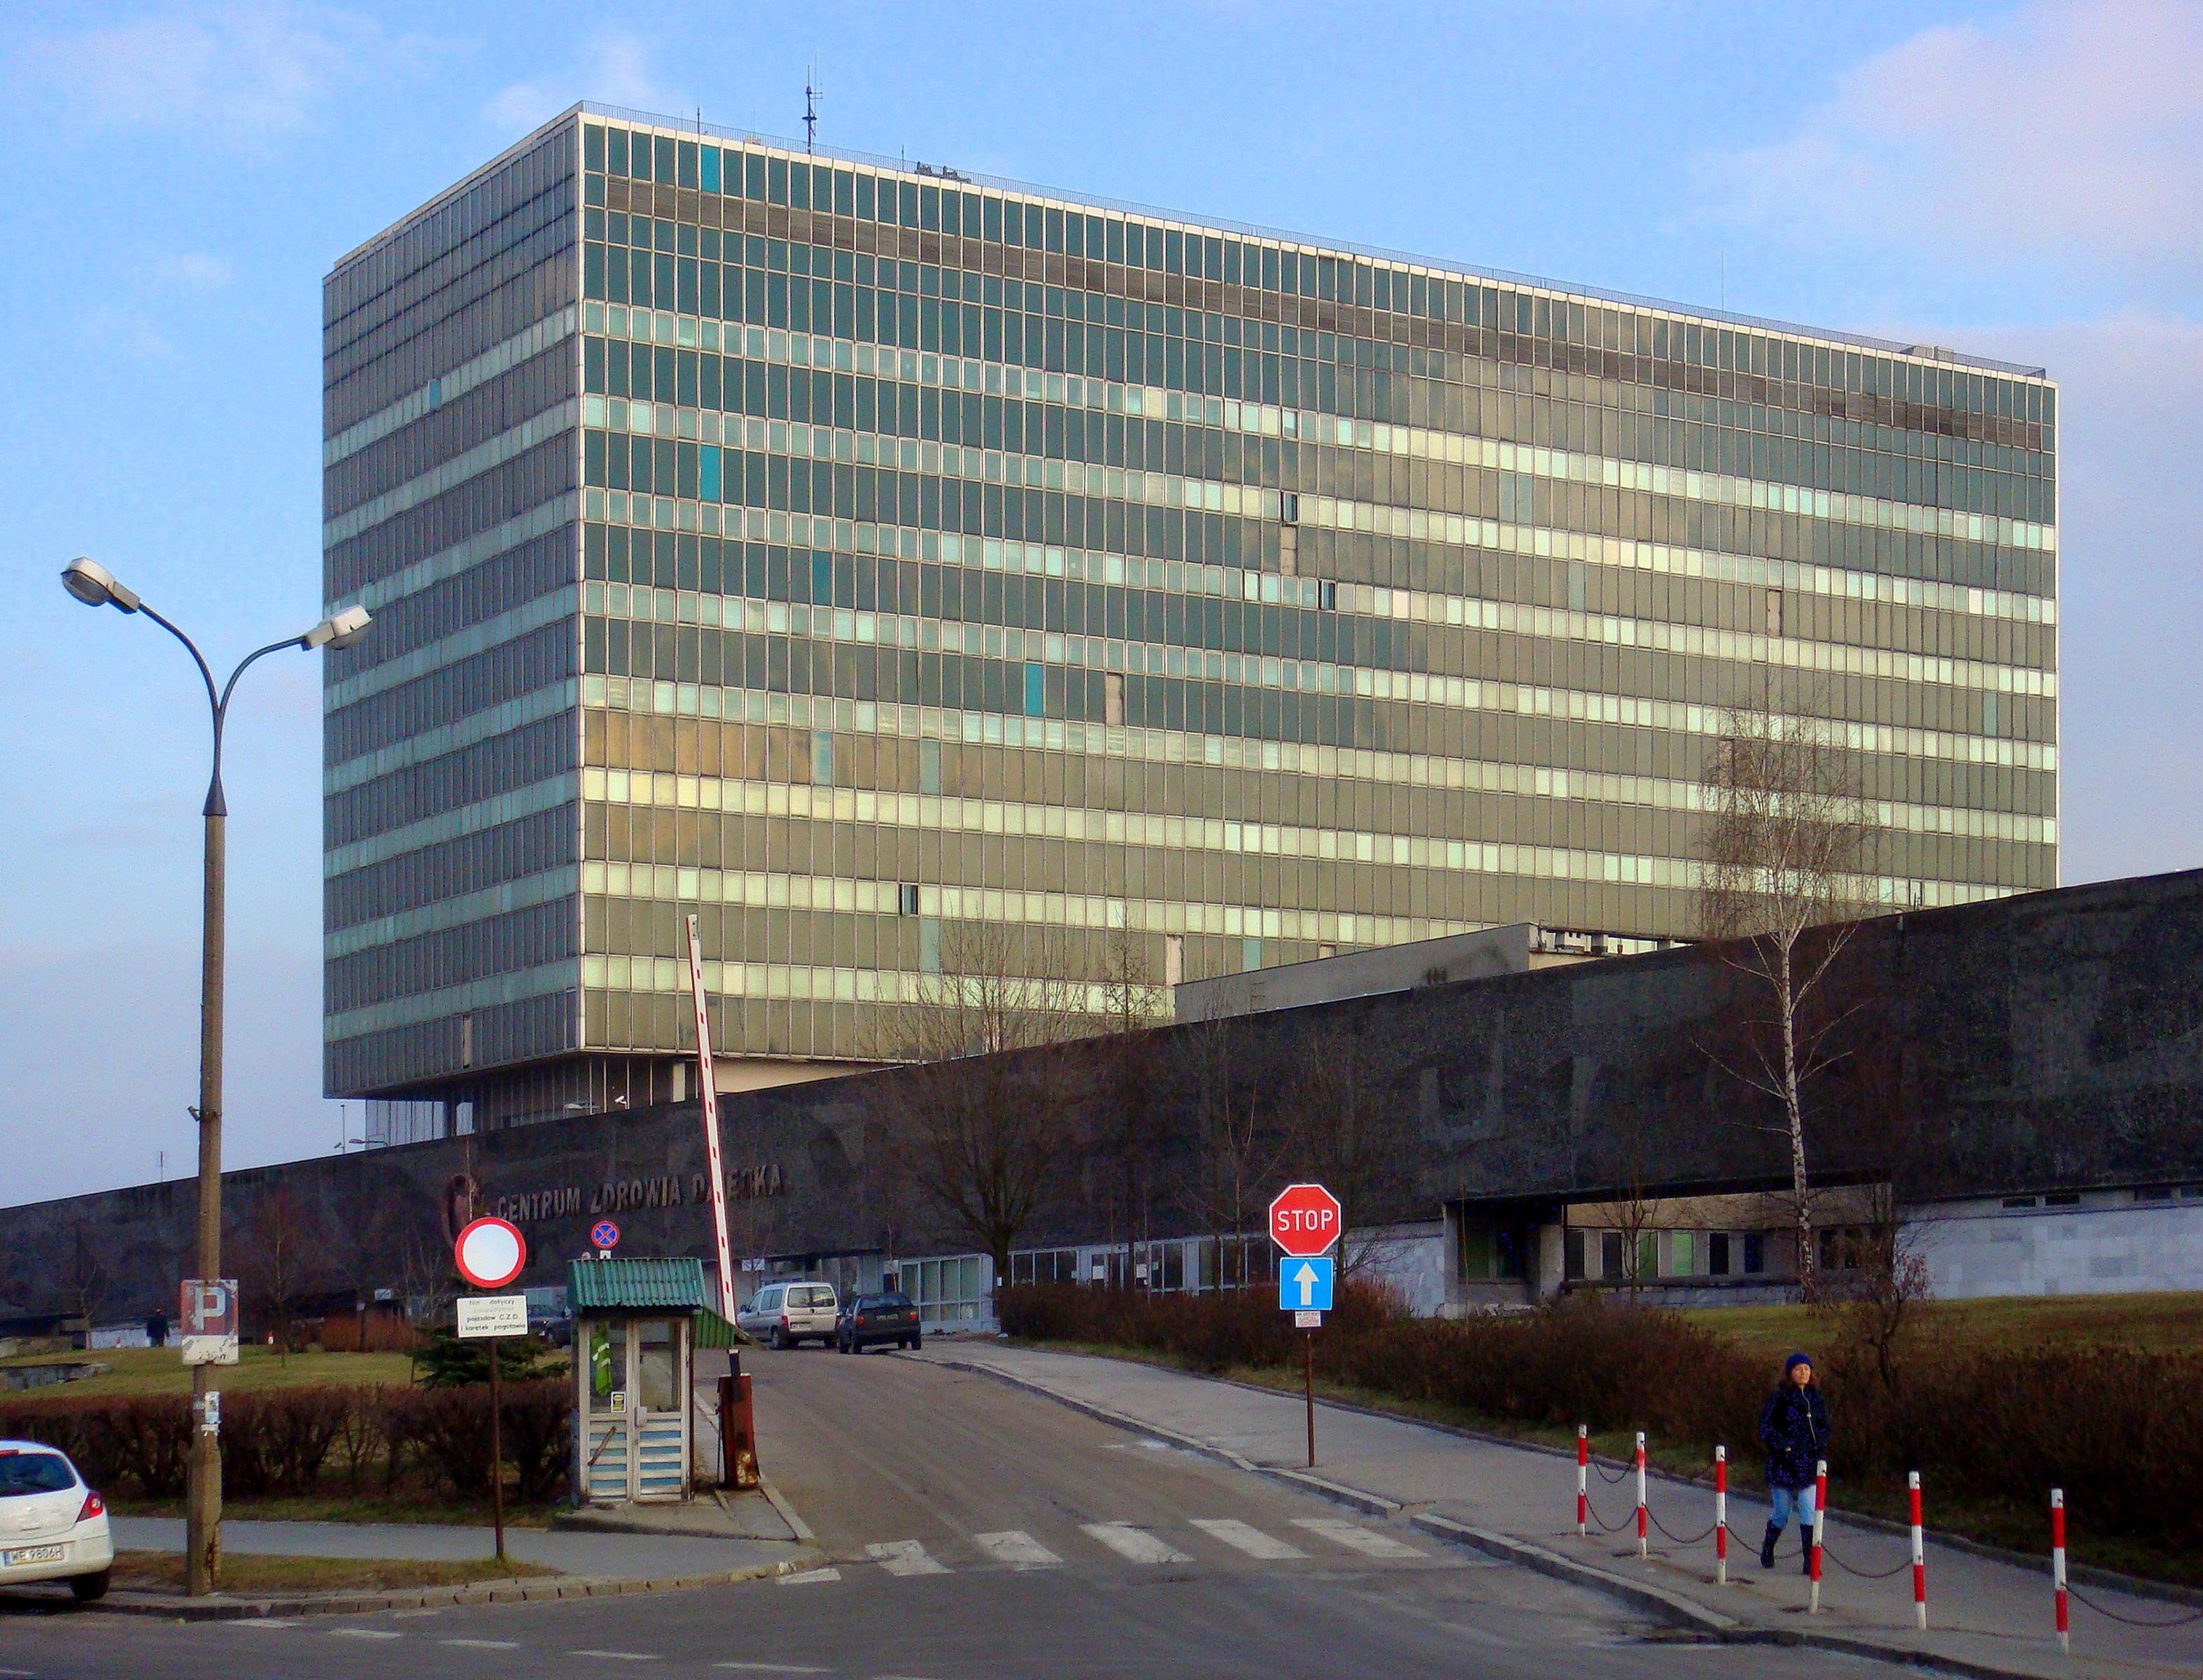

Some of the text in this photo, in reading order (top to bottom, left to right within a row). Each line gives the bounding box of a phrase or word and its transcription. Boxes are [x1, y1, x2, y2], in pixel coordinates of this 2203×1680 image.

[498, 1187, 581, 1221] CENTRUM
[590, 1174, 682, 1215] ZDROWIA
[1278, 1209, 1333, 1231] STOP
[195, 1287, 225, 1330] P
[493, 1322, 526, 1331] pogotowia
